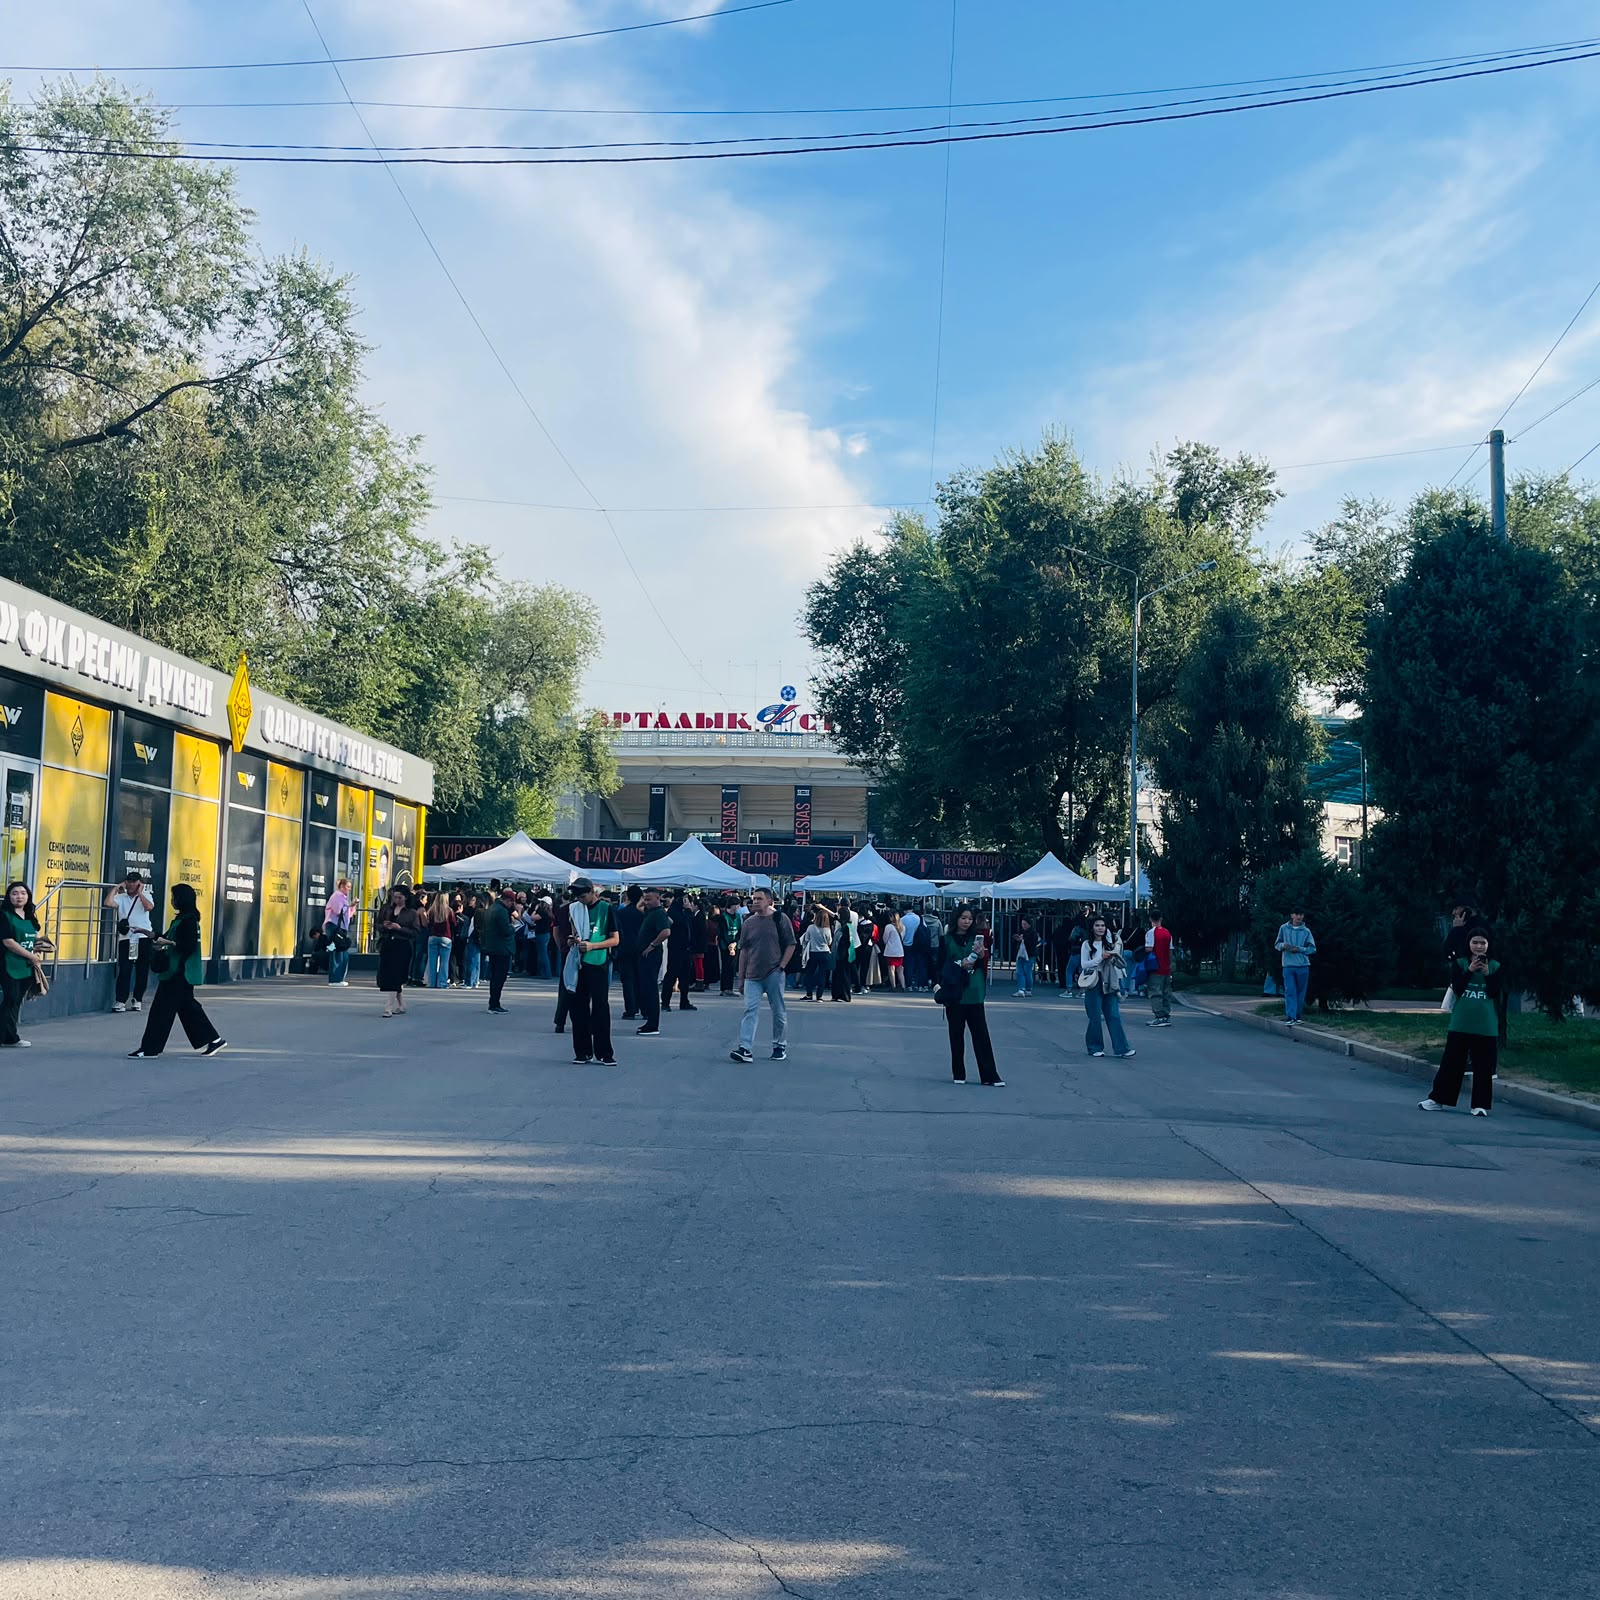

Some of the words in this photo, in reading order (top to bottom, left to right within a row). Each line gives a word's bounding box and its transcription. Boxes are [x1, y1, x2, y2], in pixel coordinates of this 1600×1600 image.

[23, 609, 68, 666] ФК
[67, 624, 141, 692] РЕСМИ
[262, 704, 315, 750] QAIRAT
[315, 725, 329, 758] FC
[329, 731, 375, 774] OFFICIAL
[376, 750, 403, 784] STORE
[442, 843, 462, 859] VIP
[586, 846, 611, 863] FAN
[613, 847, 646, 863] ZONE
[713, 850, 736, 867] NCE
[740, 851, 779, 868] FLOOR
[943, 867, 976, 878] СЕКТОРЫ
